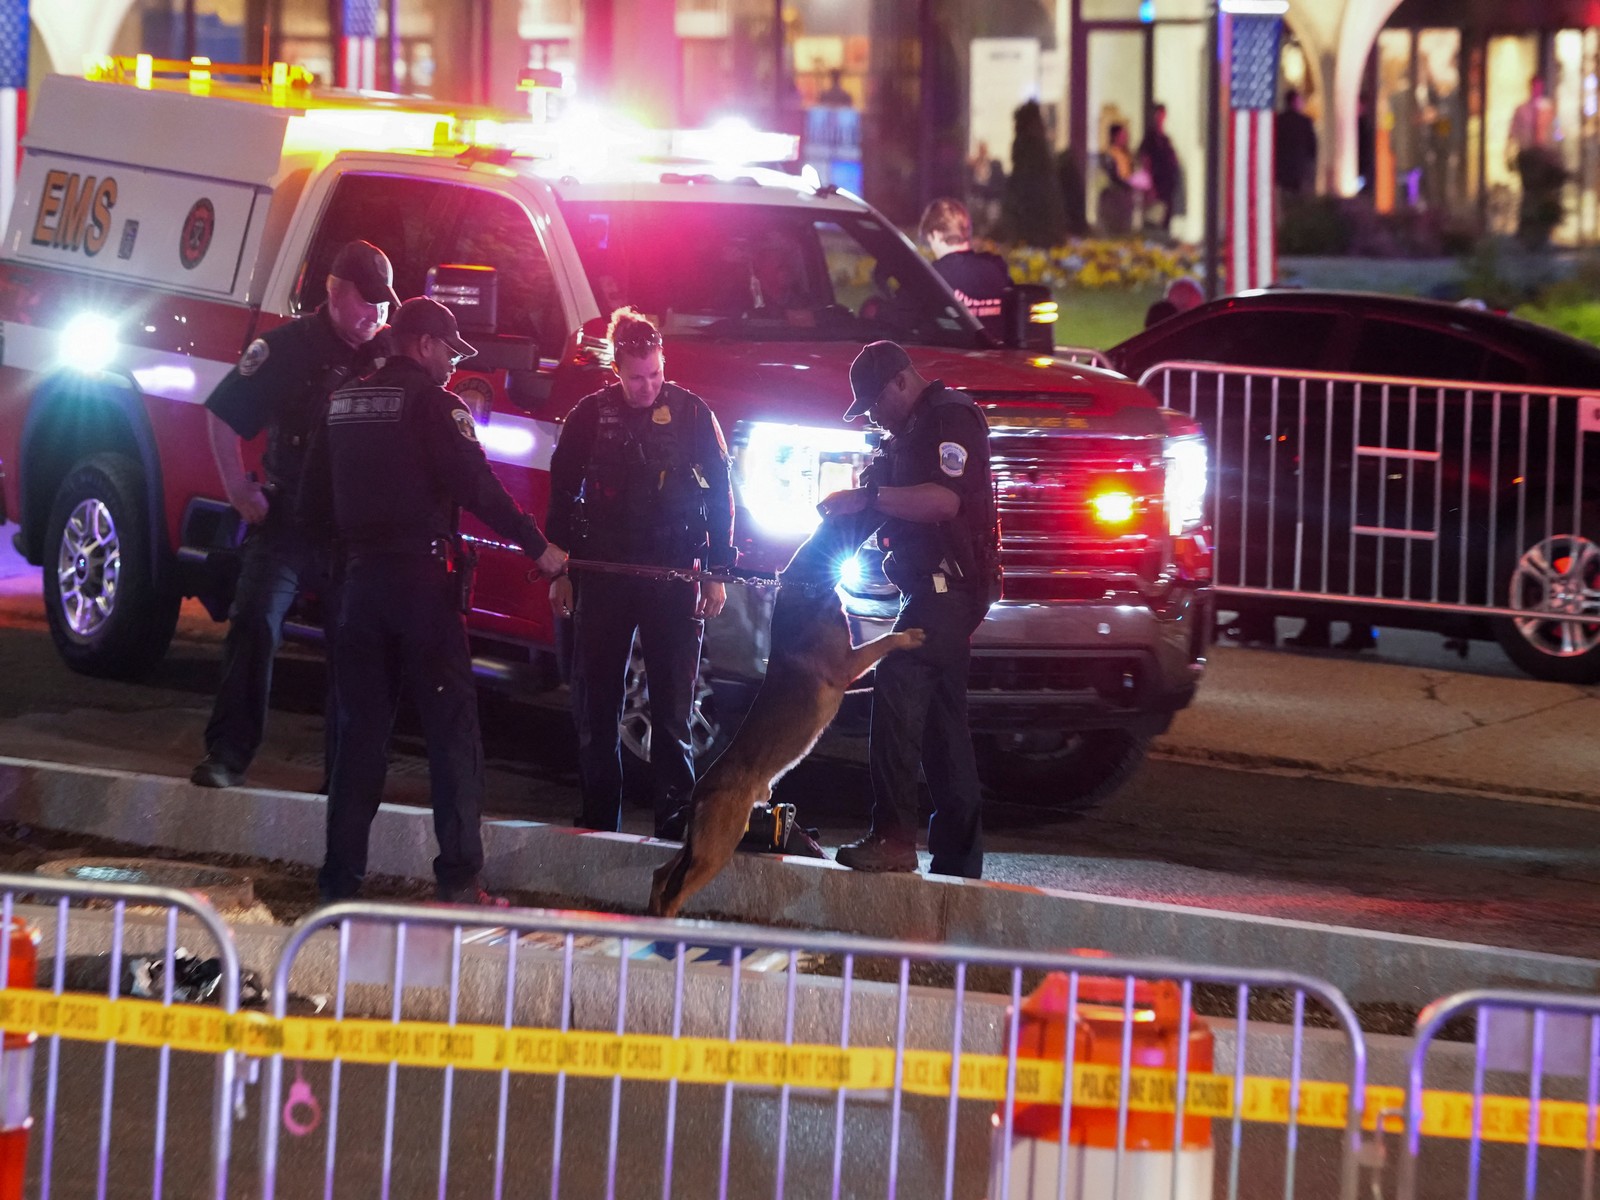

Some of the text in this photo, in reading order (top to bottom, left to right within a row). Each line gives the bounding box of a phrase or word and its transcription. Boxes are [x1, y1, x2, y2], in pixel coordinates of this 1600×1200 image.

[31, 169, 118, 257] EMS
[140, 1010, 176, 1038] POLICE
[325, 1026, 363, 1054] POLICE
[367, 1029, 390, 1055] LINE
[413, 1031, 435, 1057] NOT
[438, 1032, 474, 1060] CROSS
[515, 1035, 662, 1071] POLICE LINE DO NOT CROSS
[704, 1046, 850, 1082] POLICE LINE DO NOT CROSS
